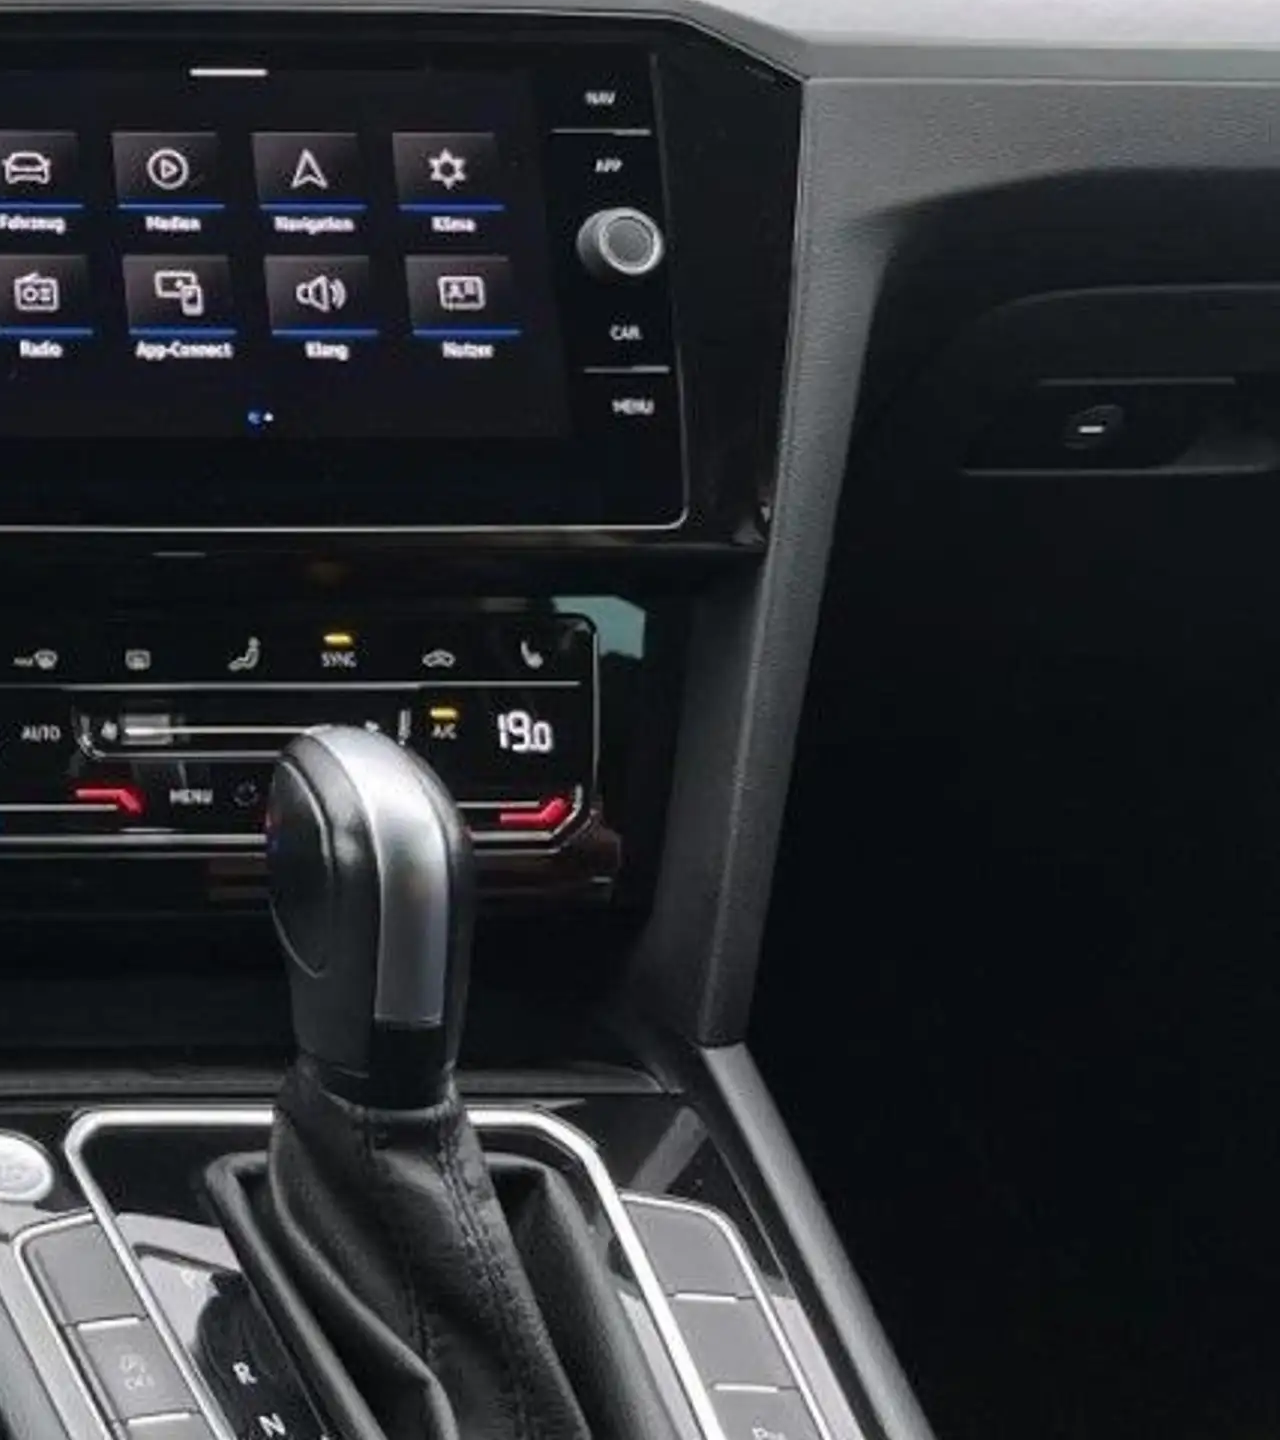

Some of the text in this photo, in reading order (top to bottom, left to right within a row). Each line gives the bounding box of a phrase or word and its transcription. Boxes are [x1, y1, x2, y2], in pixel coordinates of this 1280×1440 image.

[586, 92, 615, 104] NAV
[596, 159, 622, 172] APP
[146, 216, 200, 231] Medien
[275, 216, 354, 234] Navigation
[432, 217, 475, 231] Klima
[611, 326, 640, 340] CAR
[20, 340, 62, 357] Radio
[136, 341, 232, 360] App-Connect
[306, 342, 348, 360] Klang
[443, 342, 492, 358] Nutzer
[613, 399, 654, 414] MENU
[322, 652, 356, 667] SYNC
[22, 726, 60, 741] AUTO
[498, 711, 552, 752] 19.0
[170, 789, 212, 803] MENU
[233, 1362, 257, 1384] R
[259, 1413, 286, 1438] N
